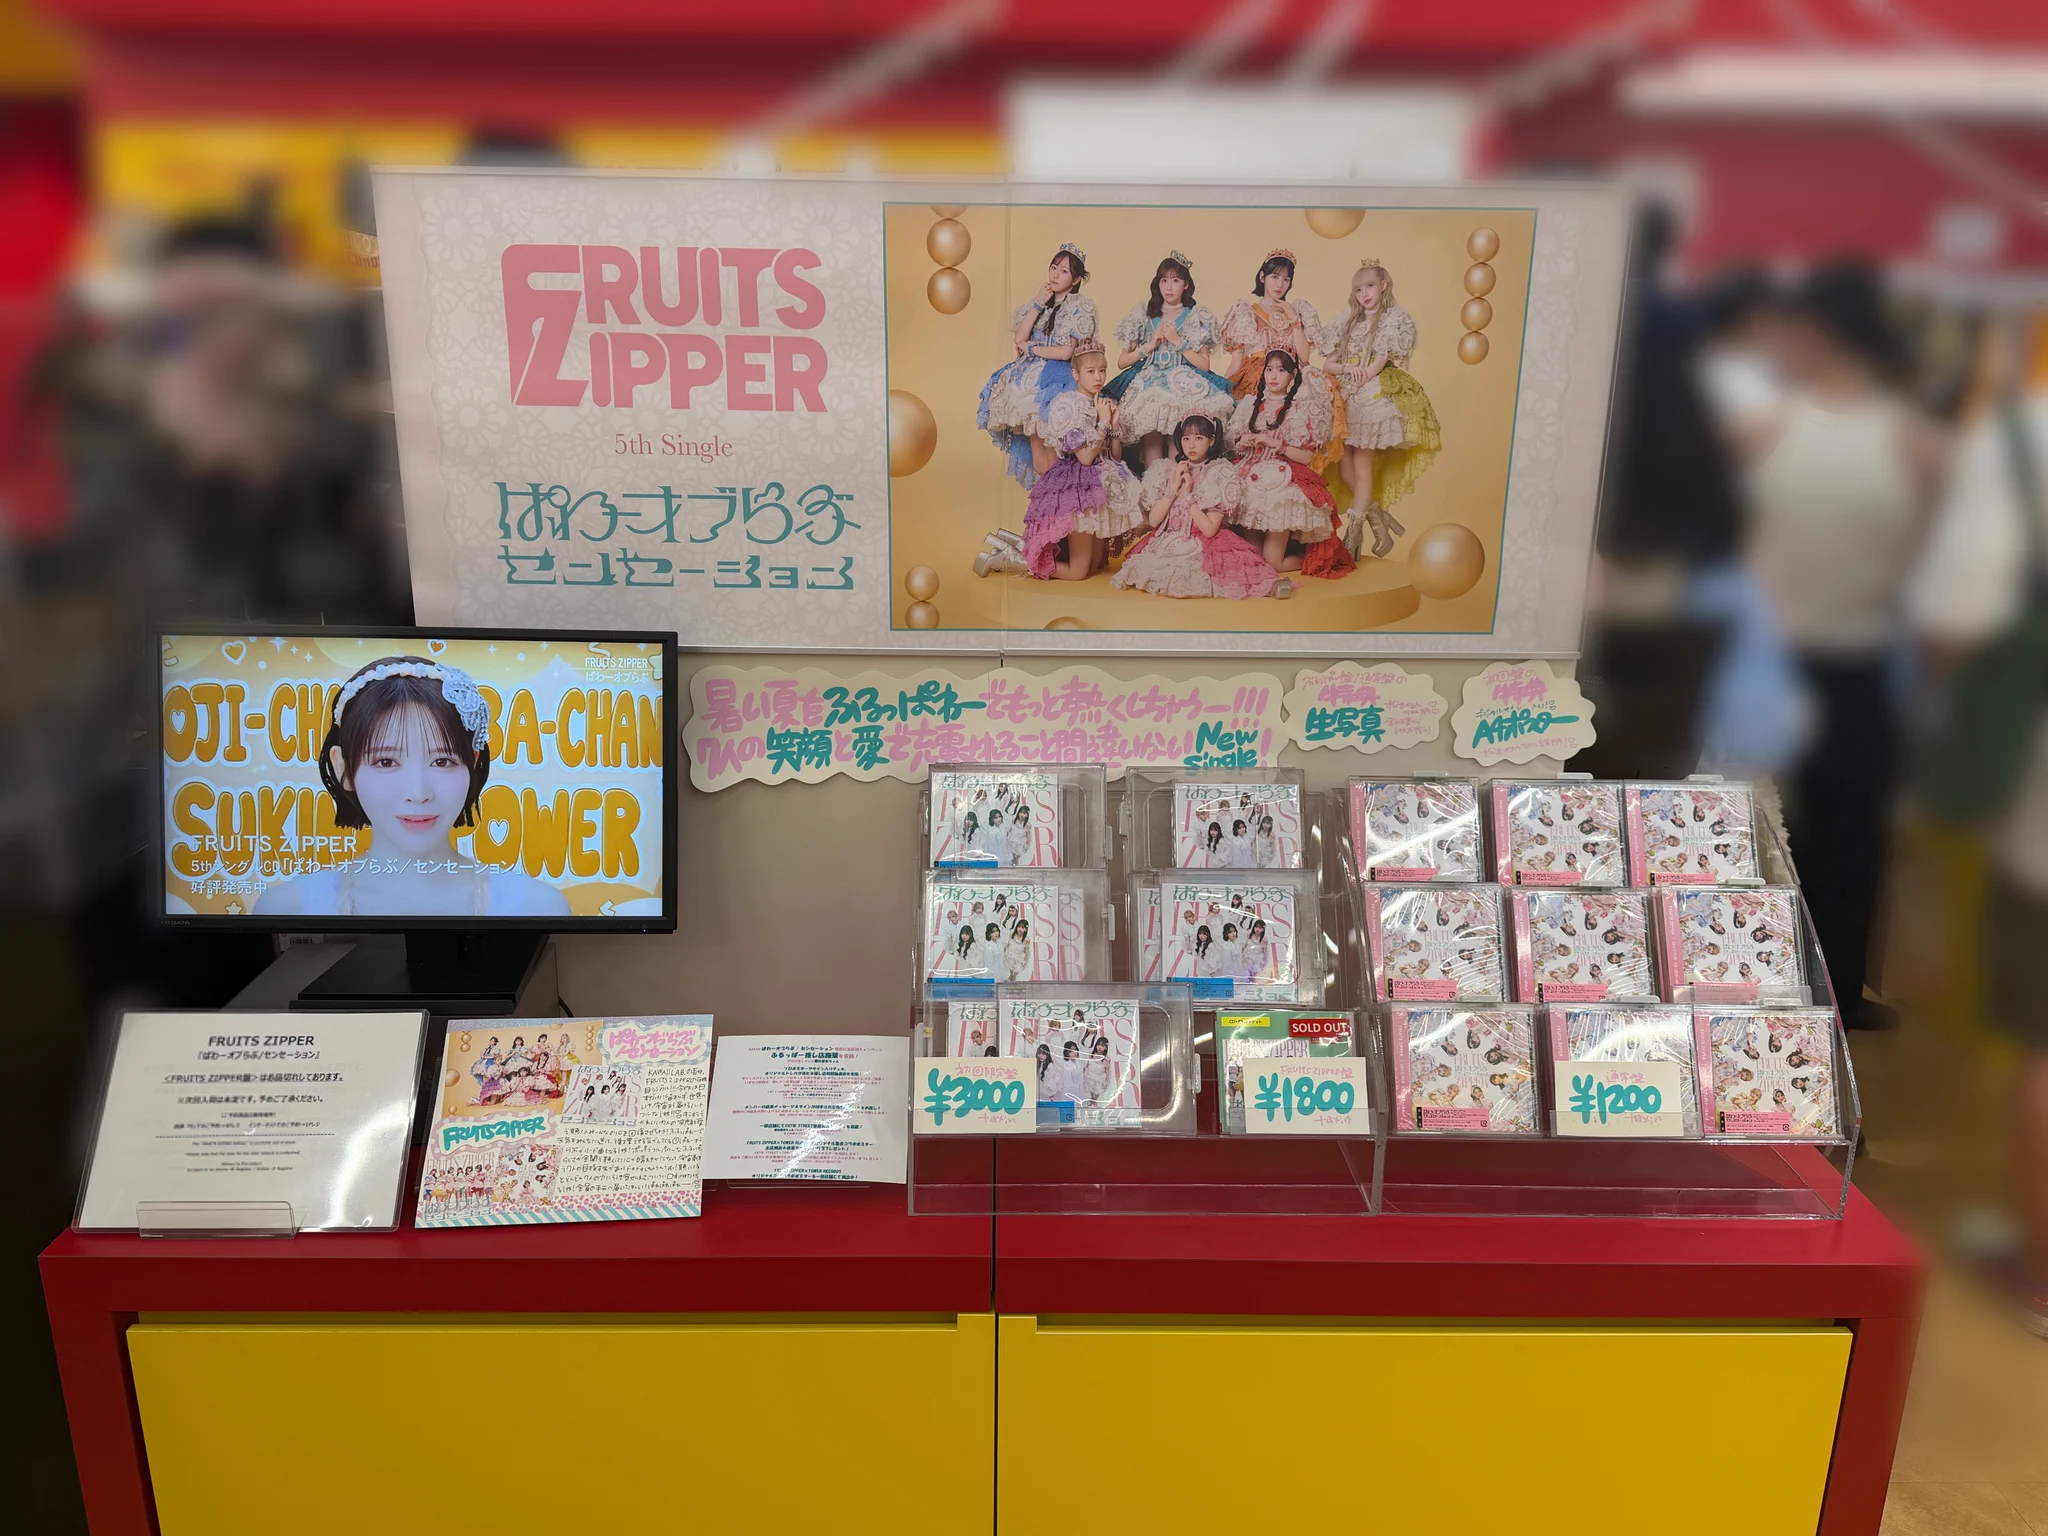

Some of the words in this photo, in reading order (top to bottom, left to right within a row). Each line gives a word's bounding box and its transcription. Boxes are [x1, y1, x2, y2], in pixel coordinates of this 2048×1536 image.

[501, 243, 827, 331] FRUITS
[511, 320, 829, 413] ZIPPER
[615, 433, 652, 456] 5th
[661, 434, 734, 464] Single
[497, 545, 855, 591] センセーション
[585, 657, 616, 669] FRUITS
[618, 658, 648, 669] ZIPPER
[1195, 720, 1259, 753] New
[1305, 704, 1386, 745] 生写真
[190, 836, 272, 853] FRUITS
[279, 836, 357, 854] ZIPPER
[190, 879, 268, 896] 好評発売中
[208, 1035, 260, 1047] FRUITS
[263, 1035, 315, 1047] ZIPPER
[1292, 1023, 1321, 1033] SOLD
[1323, 1023, 1348, 1033] OUT
[1279, 1065, 1310, 1076] FRUITS
[923, 1067, 1026, 1127] ¥3000
[1254, 1072, 1355, 1123] ¥1800
[1569, 1074, 1662, 1125] ¥1200
